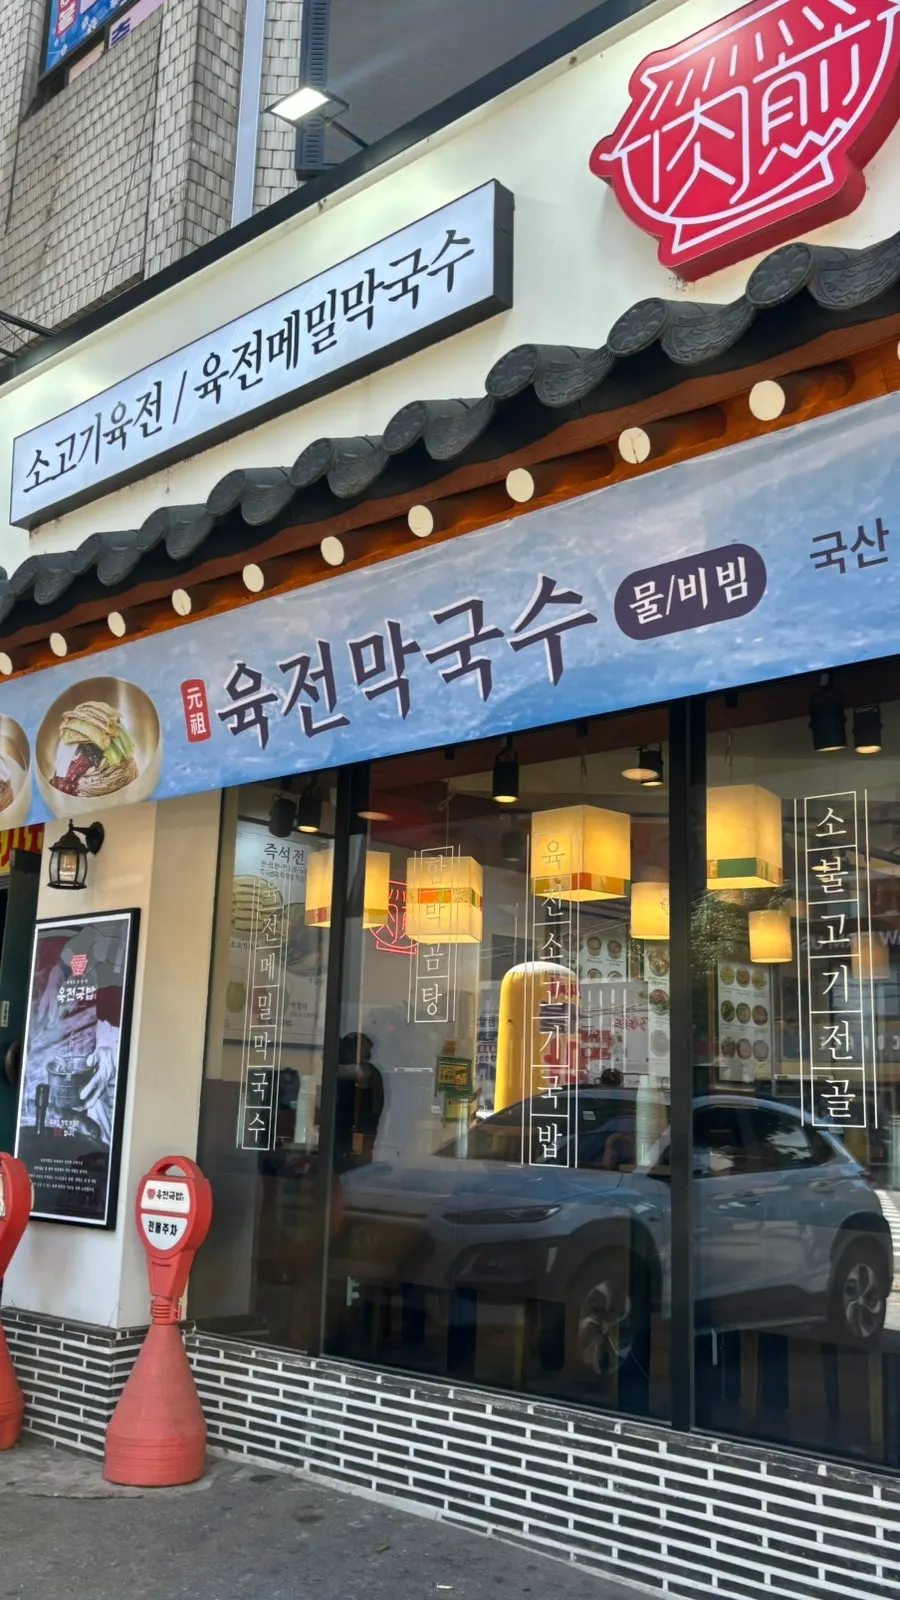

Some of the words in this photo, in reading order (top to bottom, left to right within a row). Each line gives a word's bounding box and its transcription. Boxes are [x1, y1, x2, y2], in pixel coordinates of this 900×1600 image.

[23, 379, 164, 494] 소고기육전
[172, 371, 187, 424] /
[193, 228, 476, 405] 육전메밀막국수
[808, 516, 890, 575] 국산
[185, 685, 207, 737] 元祖
[215, 571, 598, 750] 육전막국수
[247, 881, 281, 1144] 육전메밀막국수
[537, 839, 566, 1159] 육전소고기국밥
[815, 806, 857, 1119] 소불고기전골
[148, 1220, 178, 1237] 전용주차
